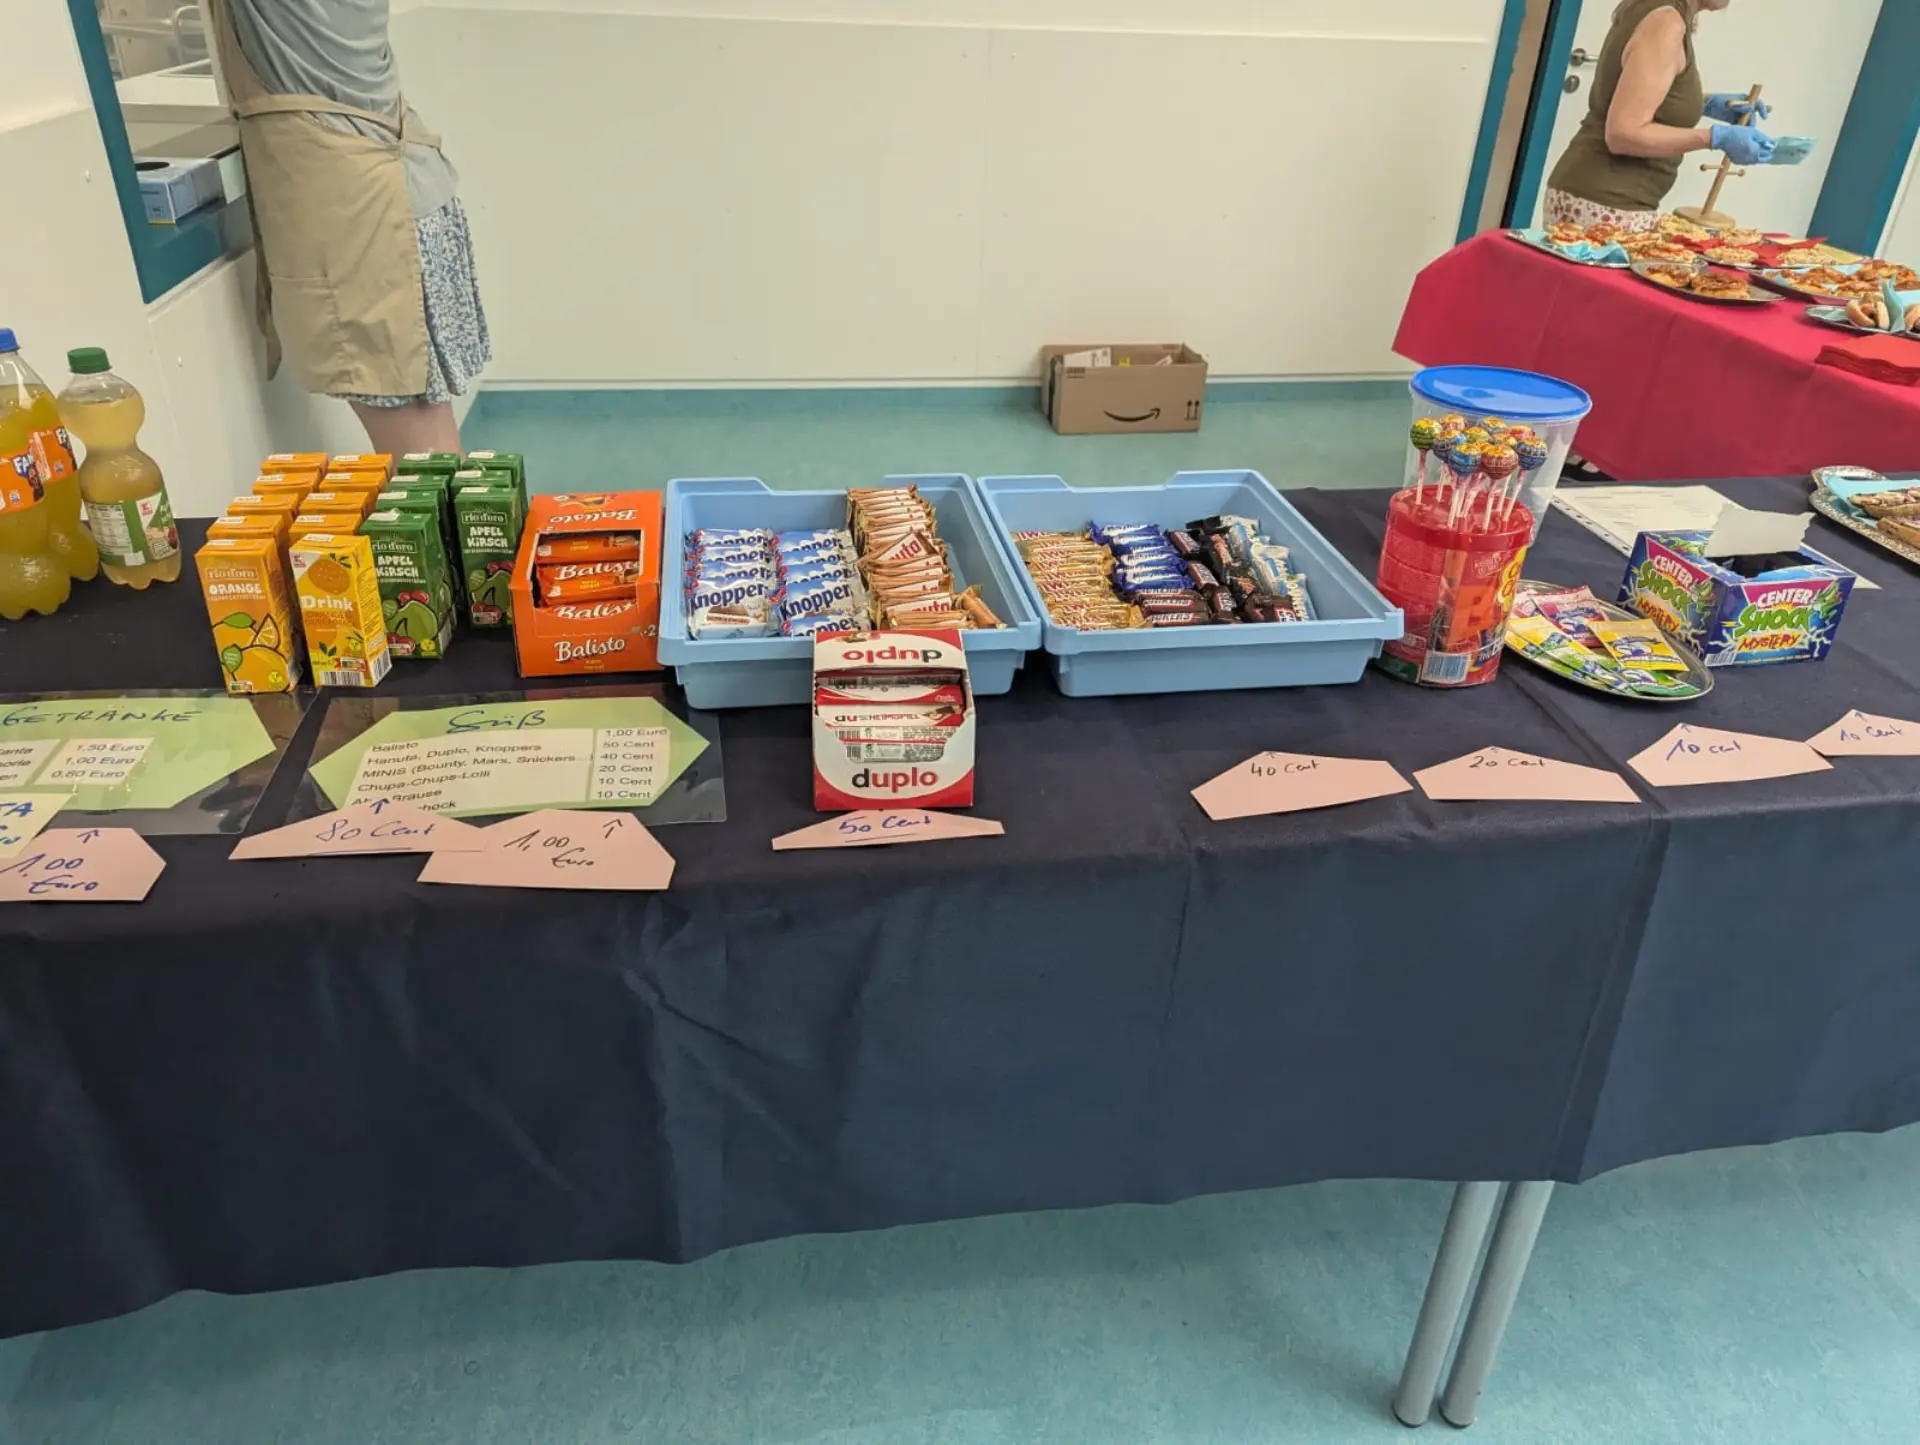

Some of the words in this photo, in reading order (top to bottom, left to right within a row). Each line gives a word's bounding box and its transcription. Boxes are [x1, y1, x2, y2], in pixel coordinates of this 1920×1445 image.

[550, 509, 638, 523] Balisto
[470, 526, 504, 536] APFEL
[377, 555, 414, 565] APFEL
[1654, 555, 1693, 590] CENTER
[209, 582, 262, 595] ORANGE
[301, 596, 354, 611] Drink
[781, 583, 853, 621] Knopper
[1757, 588, 1814, 608] CENTER
[554, 600, 635, 619] Balist
[1737, 632, 1802, 650] MYSTERY
[554, 637, 625, 662] Balisto
[842, 646, 943, 664] duplo
[3, 705, 202, 726] GETRÄNKE
[109, 743, 145, 751] Euro
[371, 742, 419, 752] Balisto
[475, 745, 542, 753] Knoppers
[99, 756, 136, 764] Euro
[1468, 755, 1498, 768] 20
[89, 769, 125, 778] Euro
[362, 767, 407, 778] MINIS
[598, 765, 616, 773] 20
[620, 765, 653, 773] Cent
[1250, 762, 1276, 777] 40
[619, 778, 652, 786] Cent
[852, 767, 939, 793] duplo
[597, 790, 613, 798] 10
[617, 790, 651, 798] Cent
[417, 800, 457, 811] hock
[370, 820, 435, 838] Cent
[551, 847, 594, 868] Euro
[28, 874, 98, 894] Euro
